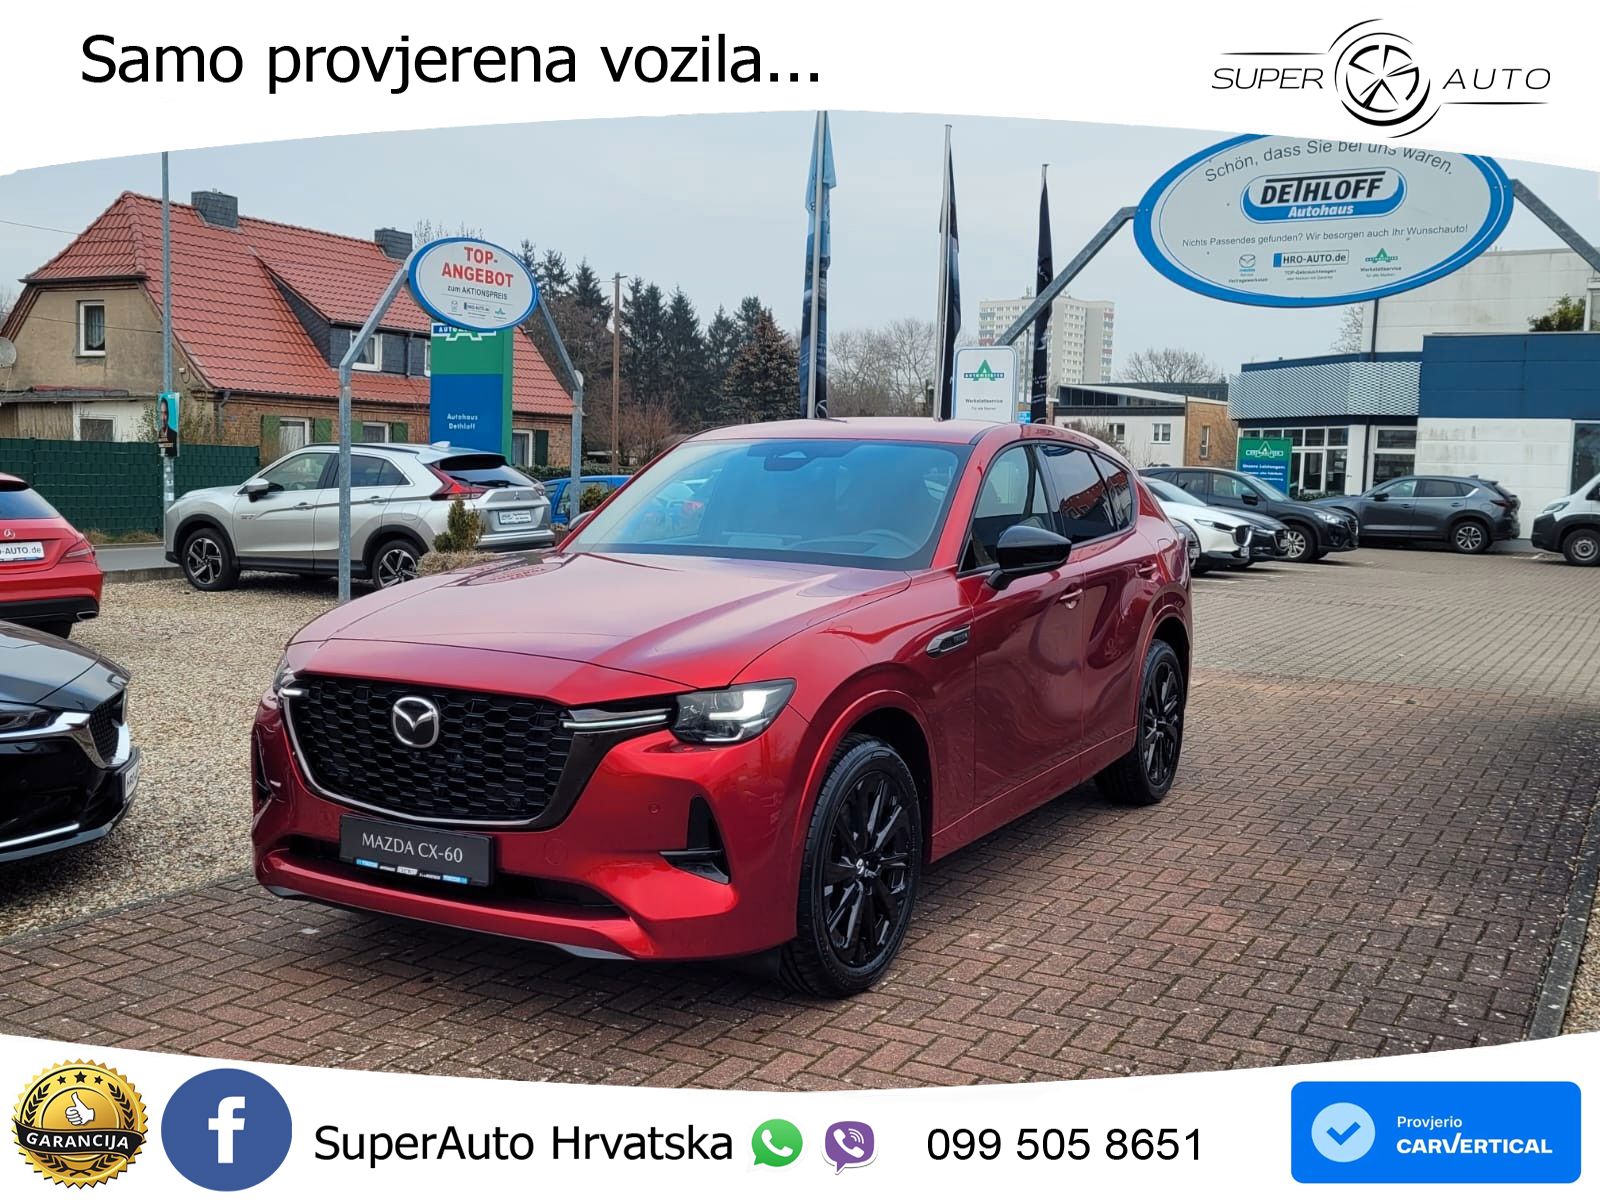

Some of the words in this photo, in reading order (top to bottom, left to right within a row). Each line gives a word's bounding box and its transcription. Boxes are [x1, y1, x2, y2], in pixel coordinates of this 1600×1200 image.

[1205, 156, 1259, 182] Schön,
[1263, 145, 1301, 162] dass
[1306, 139, 1332, 154] Sie
[1402, 146, 1452, 175] waren.
[1260, 171, 1386, 205] DETHLOFF
[1288, 204, 1354, 218] Autohaus
[1182, 238, 1208, 247] Nichts
[1210, 235, 1256, 246] Passendes
[1258, 232, 1303, 245] gefunden?
[1305, 231, 1322, 241] Wir
[1323, 229, 1365, 241] besorgen
[1366, 227, 1389, 238] auch
[1406, 224, 1469, 236] Wunschauto!
[463, 246, 499, 265] TOP-
[1283, 253, 1347, 265] HRO-AUTO.de
[441, 262, 515, 288] ANGEBOT
[447, 285, 460, 293] zum
[462, 286, 508, 301] AKTIONSPREIS
[446, 412, 479, 421] Autohaus
[448, 422, 476, 430] Dethloff
[361, 831, 416, 856] MAZDA
[418, 842, 464, 864] CX-60
